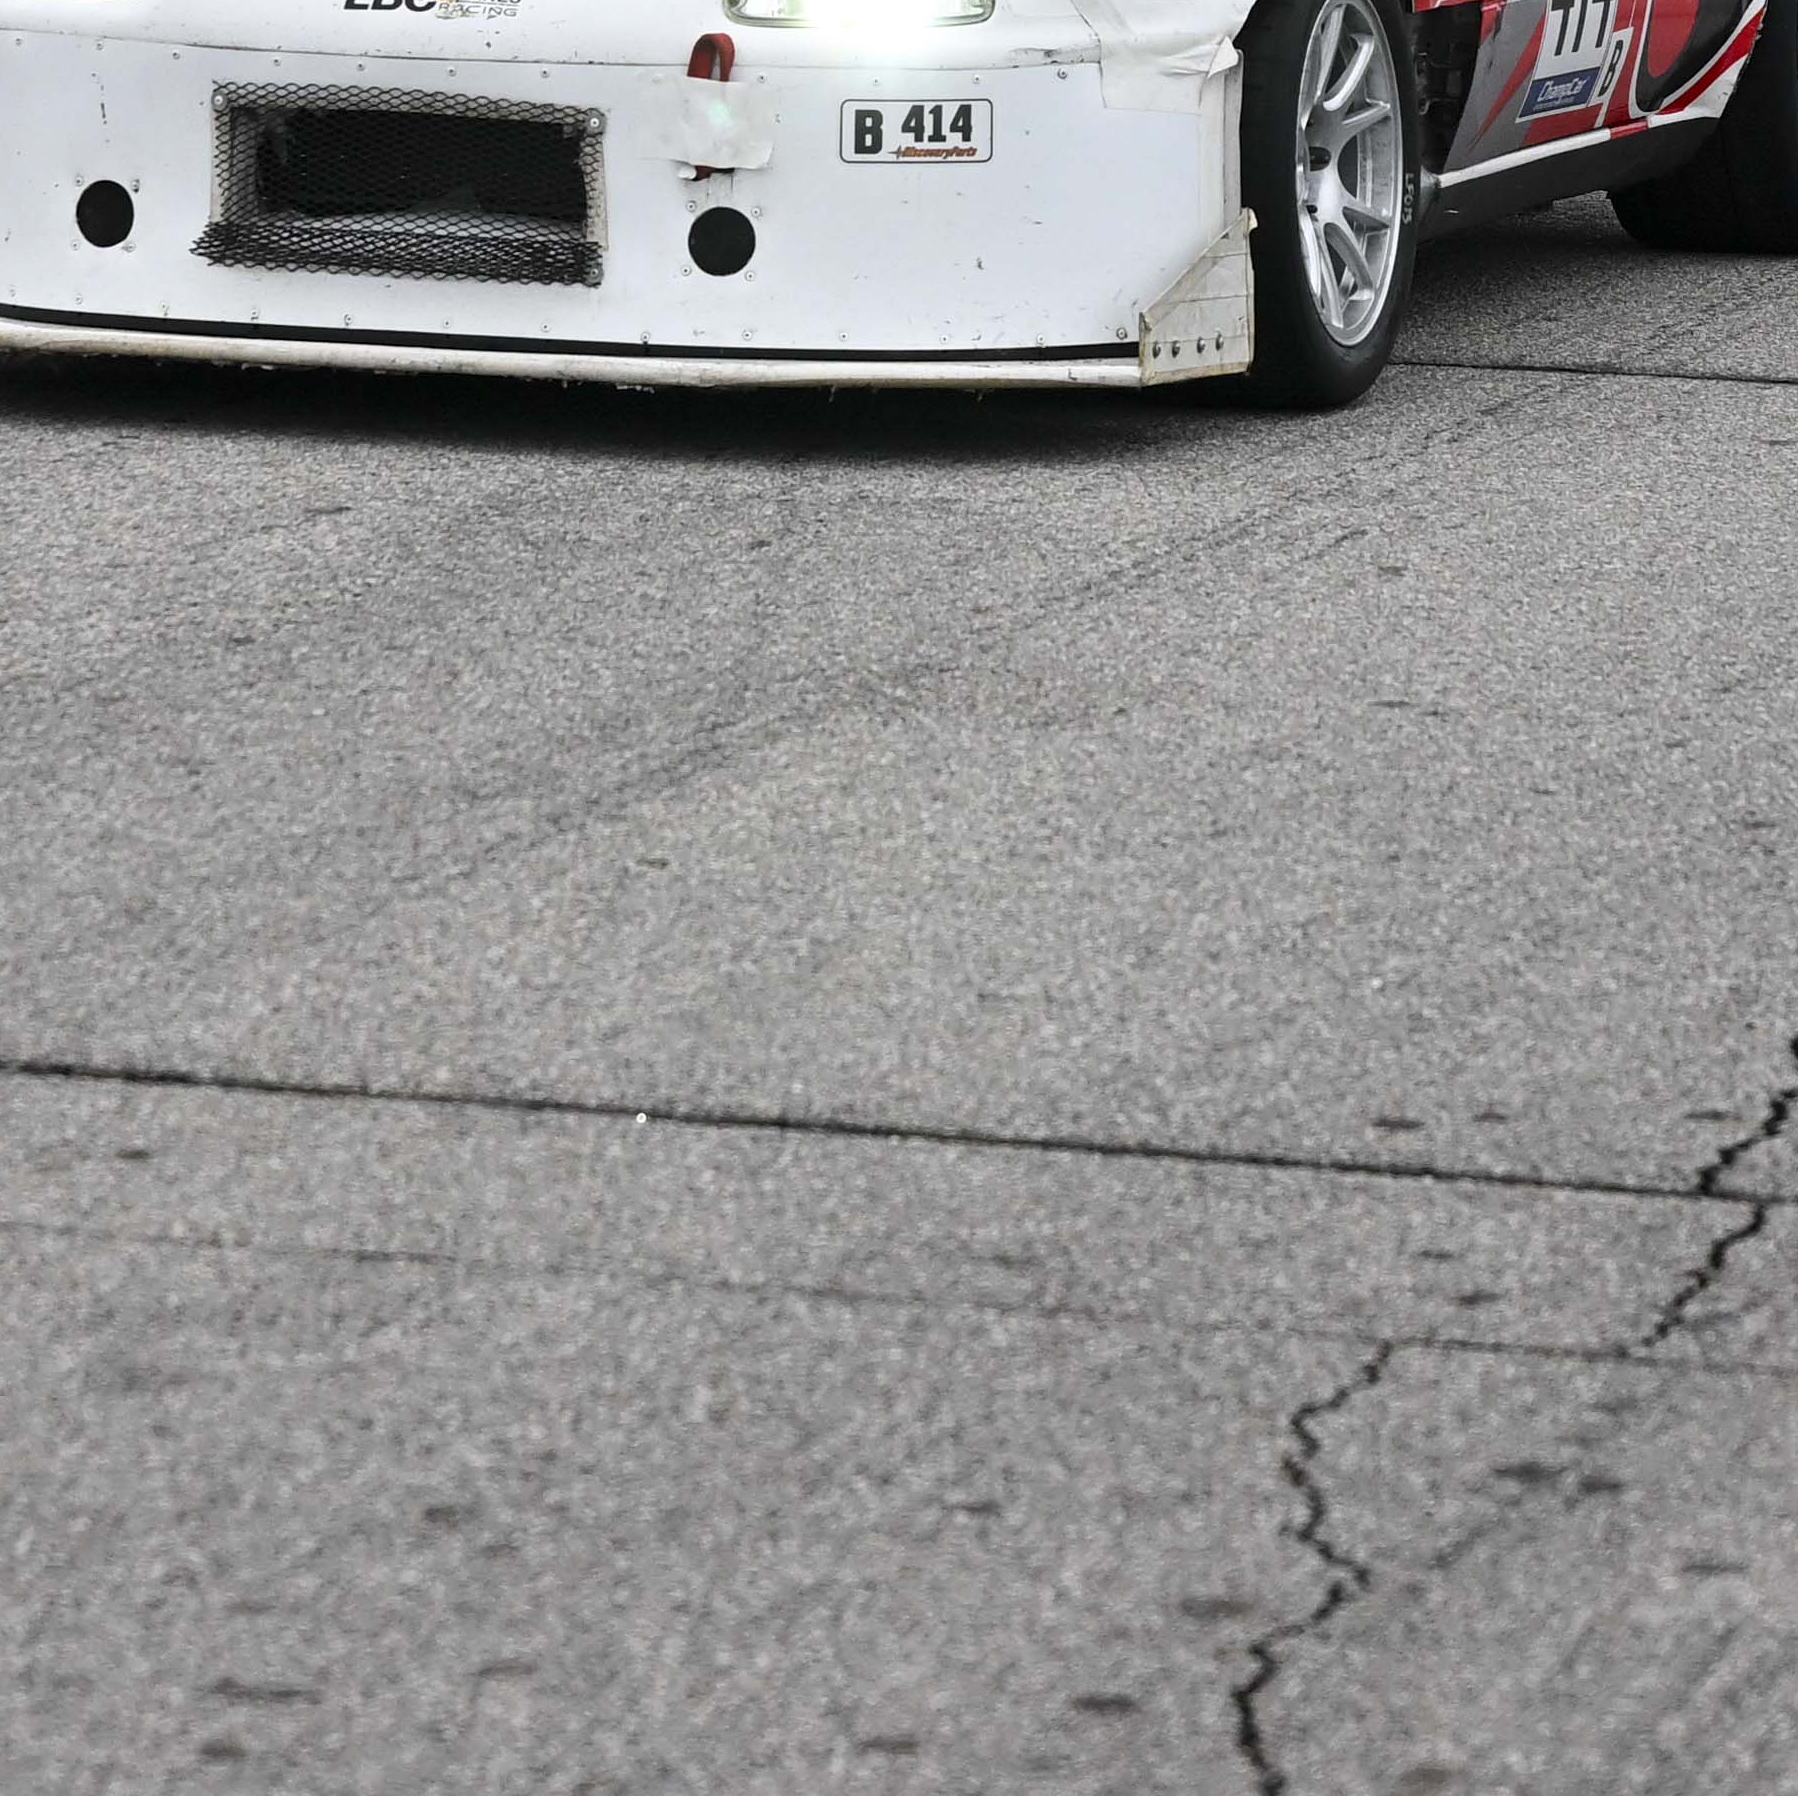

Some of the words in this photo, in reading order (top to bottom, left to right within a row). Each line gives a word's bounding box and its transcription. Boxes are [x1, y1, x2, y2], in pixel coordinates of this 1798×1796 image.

[1598, 39, 1624, 98] B
[854, 109, 884, 155] B
[901, 104, 973, 143] 414
